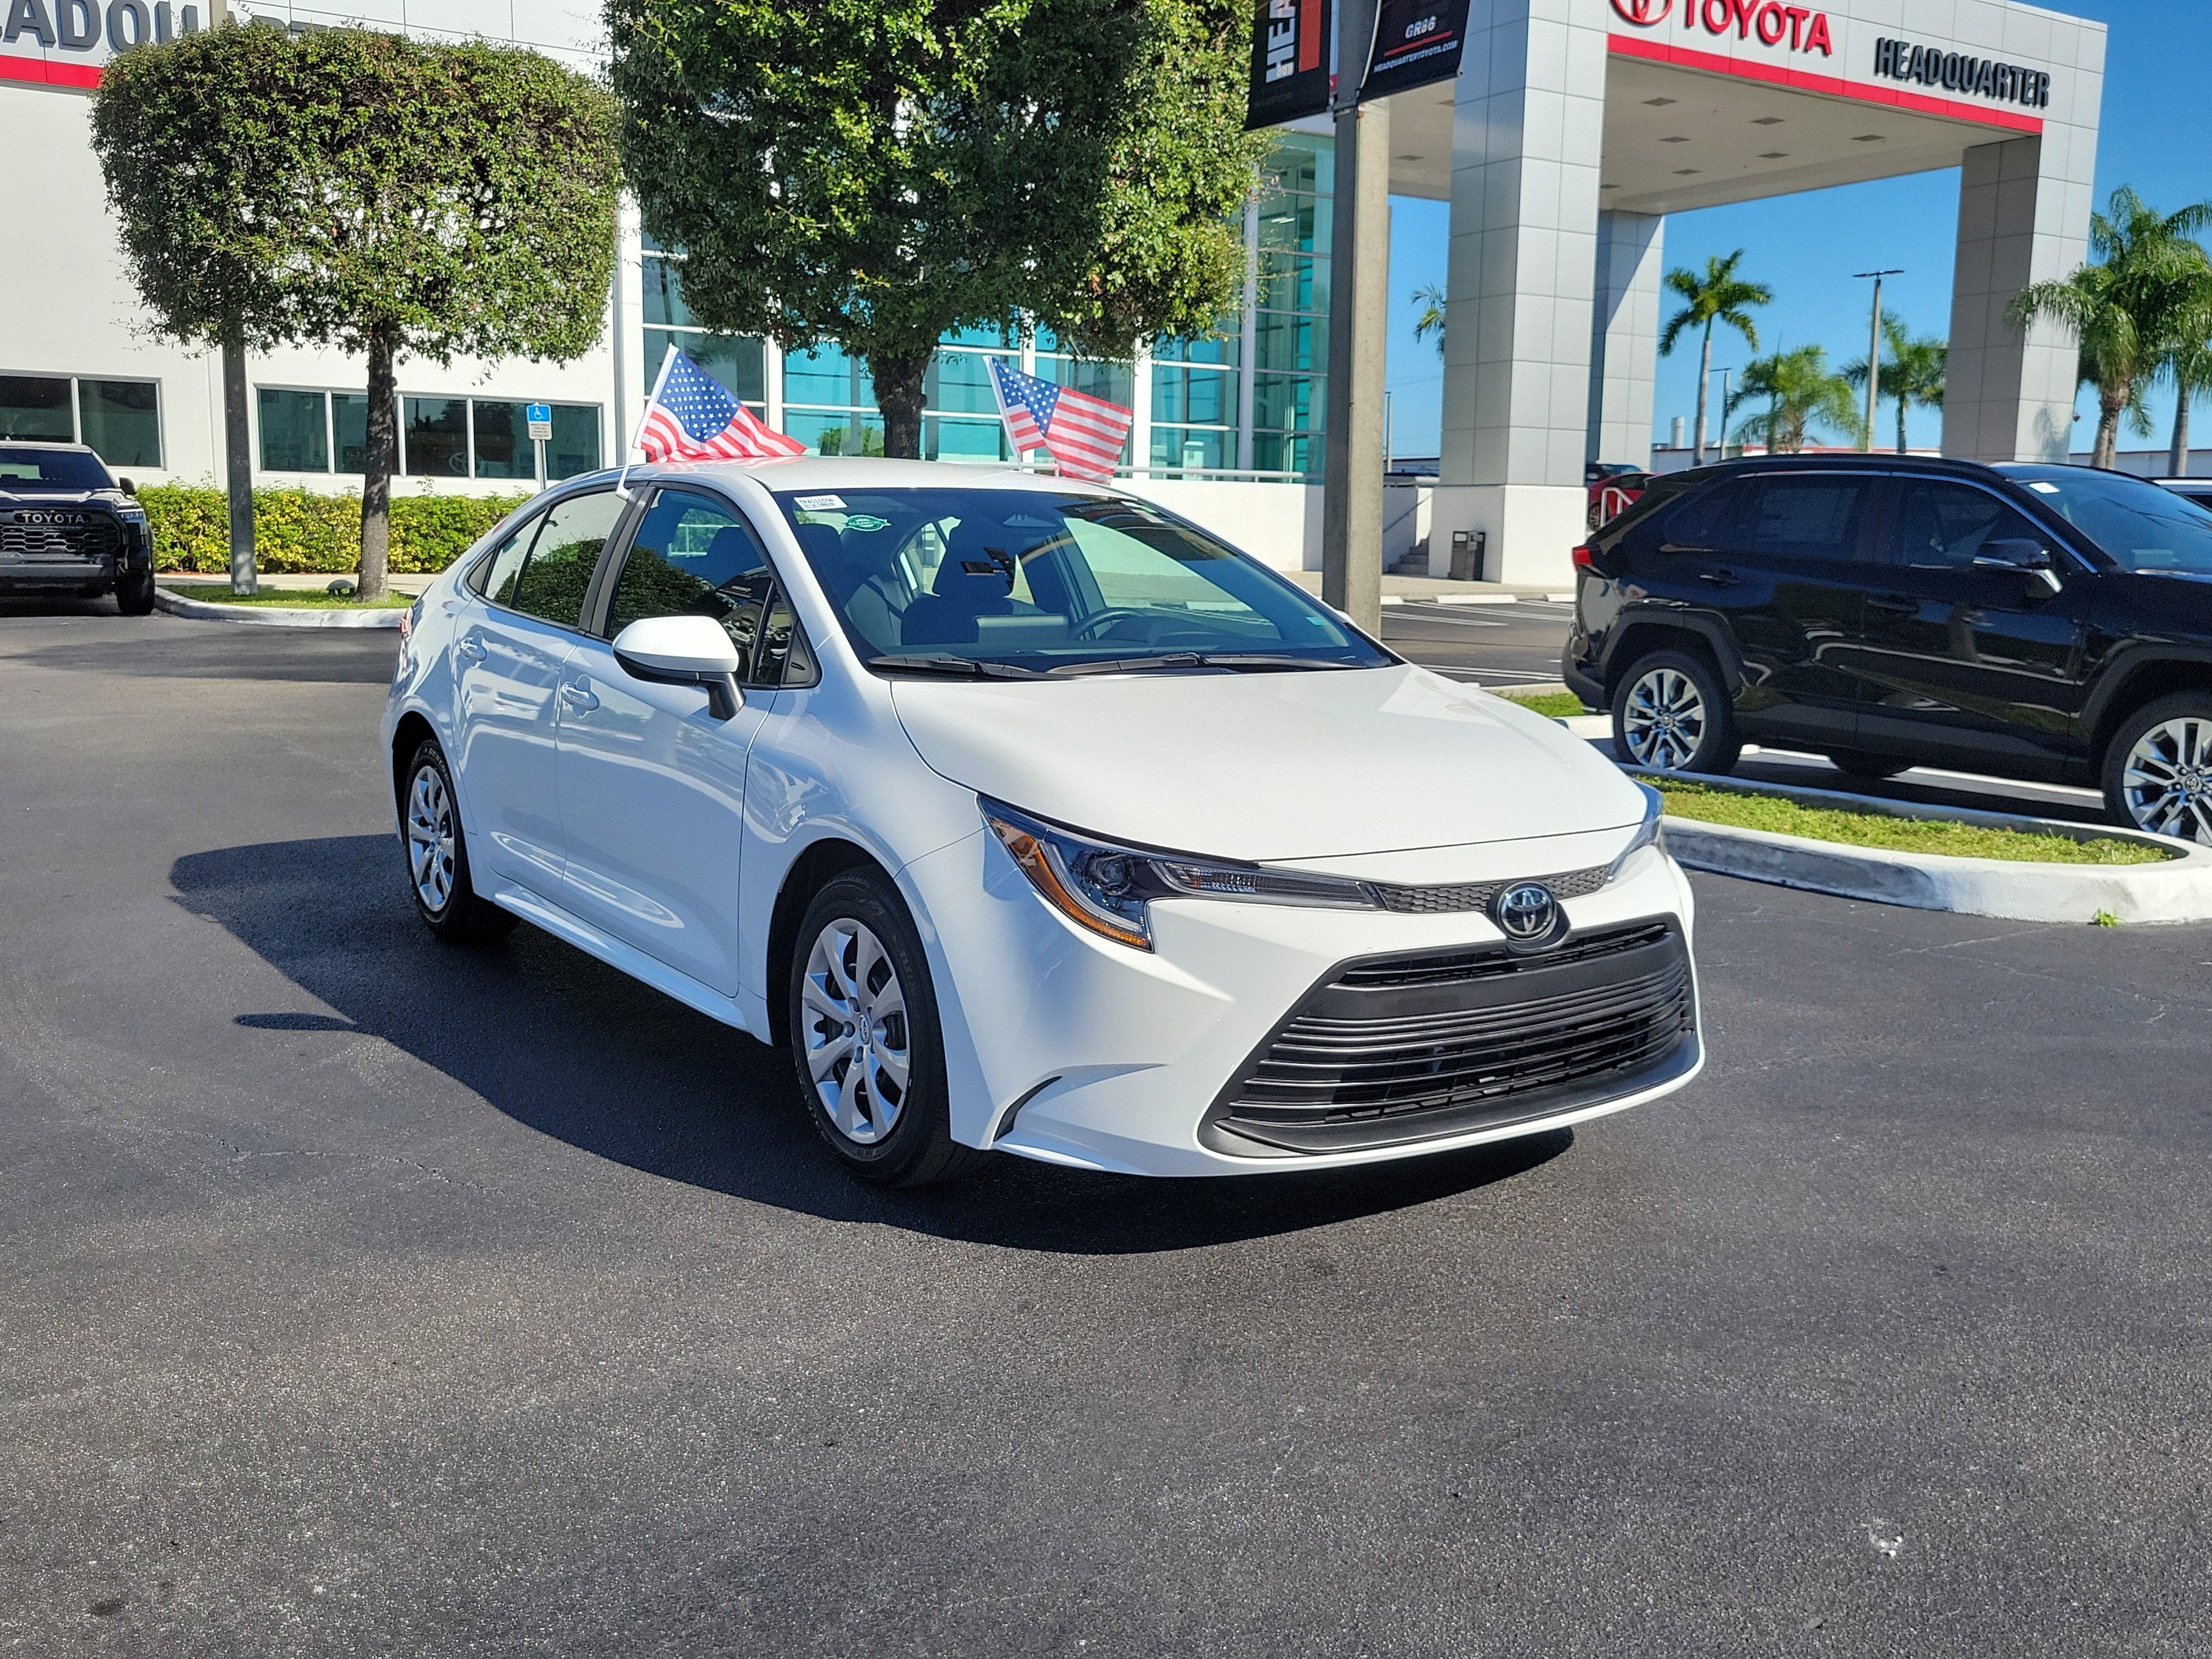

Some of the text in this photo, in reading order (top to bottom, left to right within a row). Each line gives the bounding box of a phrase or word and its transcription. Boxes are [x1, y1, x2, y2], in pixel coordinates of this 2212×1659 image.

[1683, 0, 2050, 109] TOYOTA HEADQUARTER
[22, 514, 85, 523] TOYOTA
